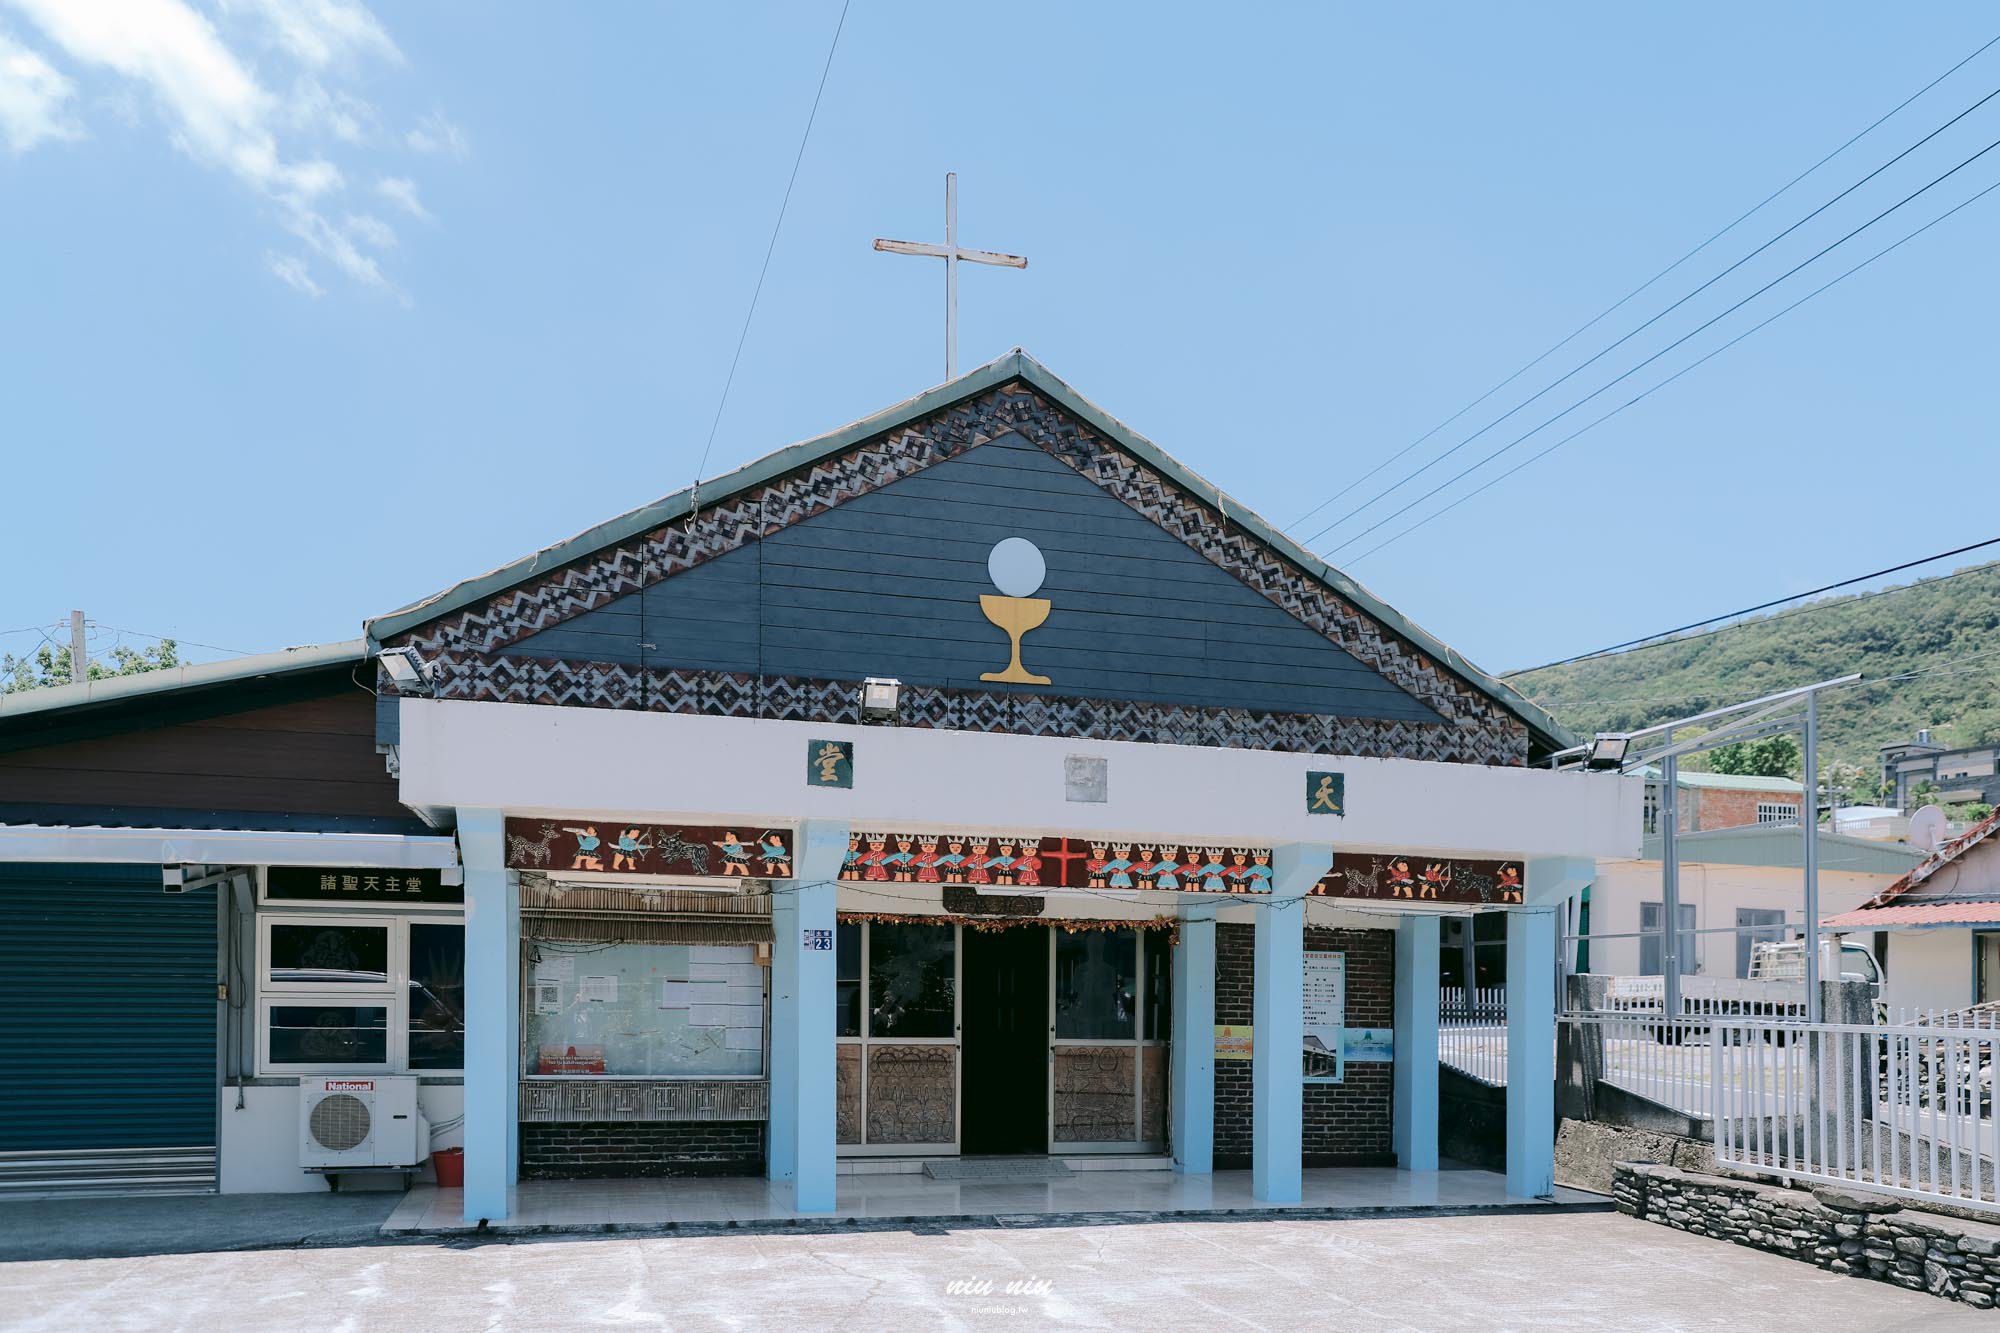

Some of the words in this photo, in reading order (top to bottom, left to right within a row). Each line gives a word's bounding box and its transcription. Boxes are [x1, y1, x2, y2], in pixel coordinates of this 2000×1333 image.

[815, 742, 844, 781] 堂
[1312, 775, 1340, 810] 天
[320, 875, 422, 893] 諸聖天主堂
[816, 938, 830, 949] 23
[328, 1082, 372, 1091] National
